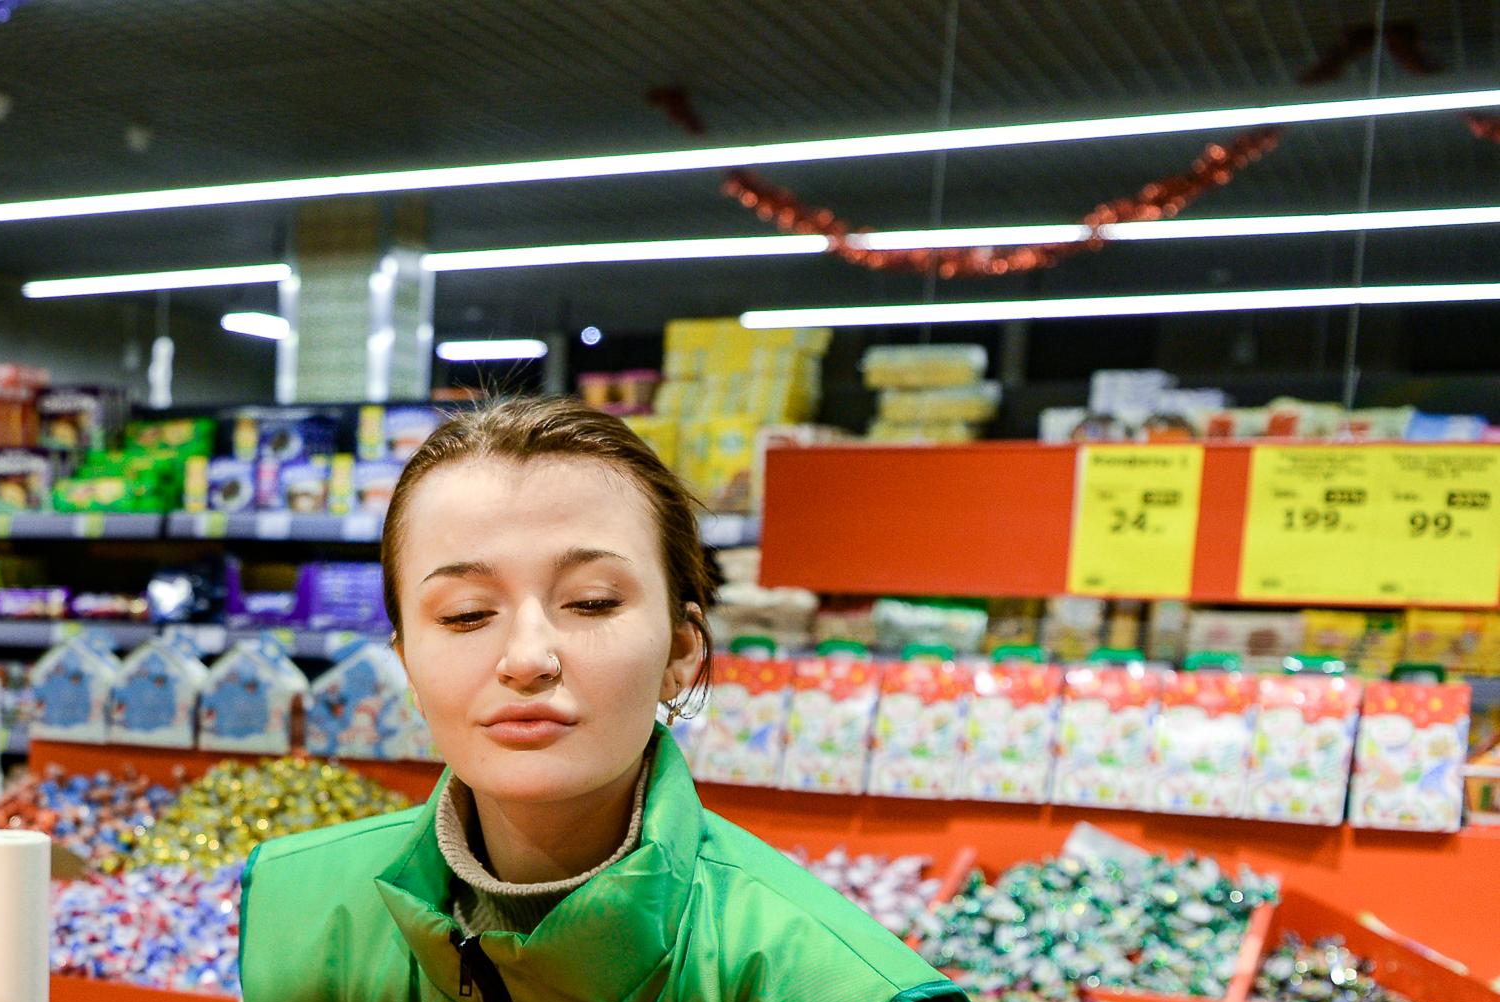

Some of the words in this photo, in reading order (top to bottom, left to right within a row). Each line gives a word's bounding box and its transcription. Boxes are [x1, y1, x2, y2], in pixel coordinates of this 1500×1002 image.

[1111, 508, 1146, 533] 24
[1284, 509, 1341, 531] 199
[1409, 512, 1453, 537] 99
